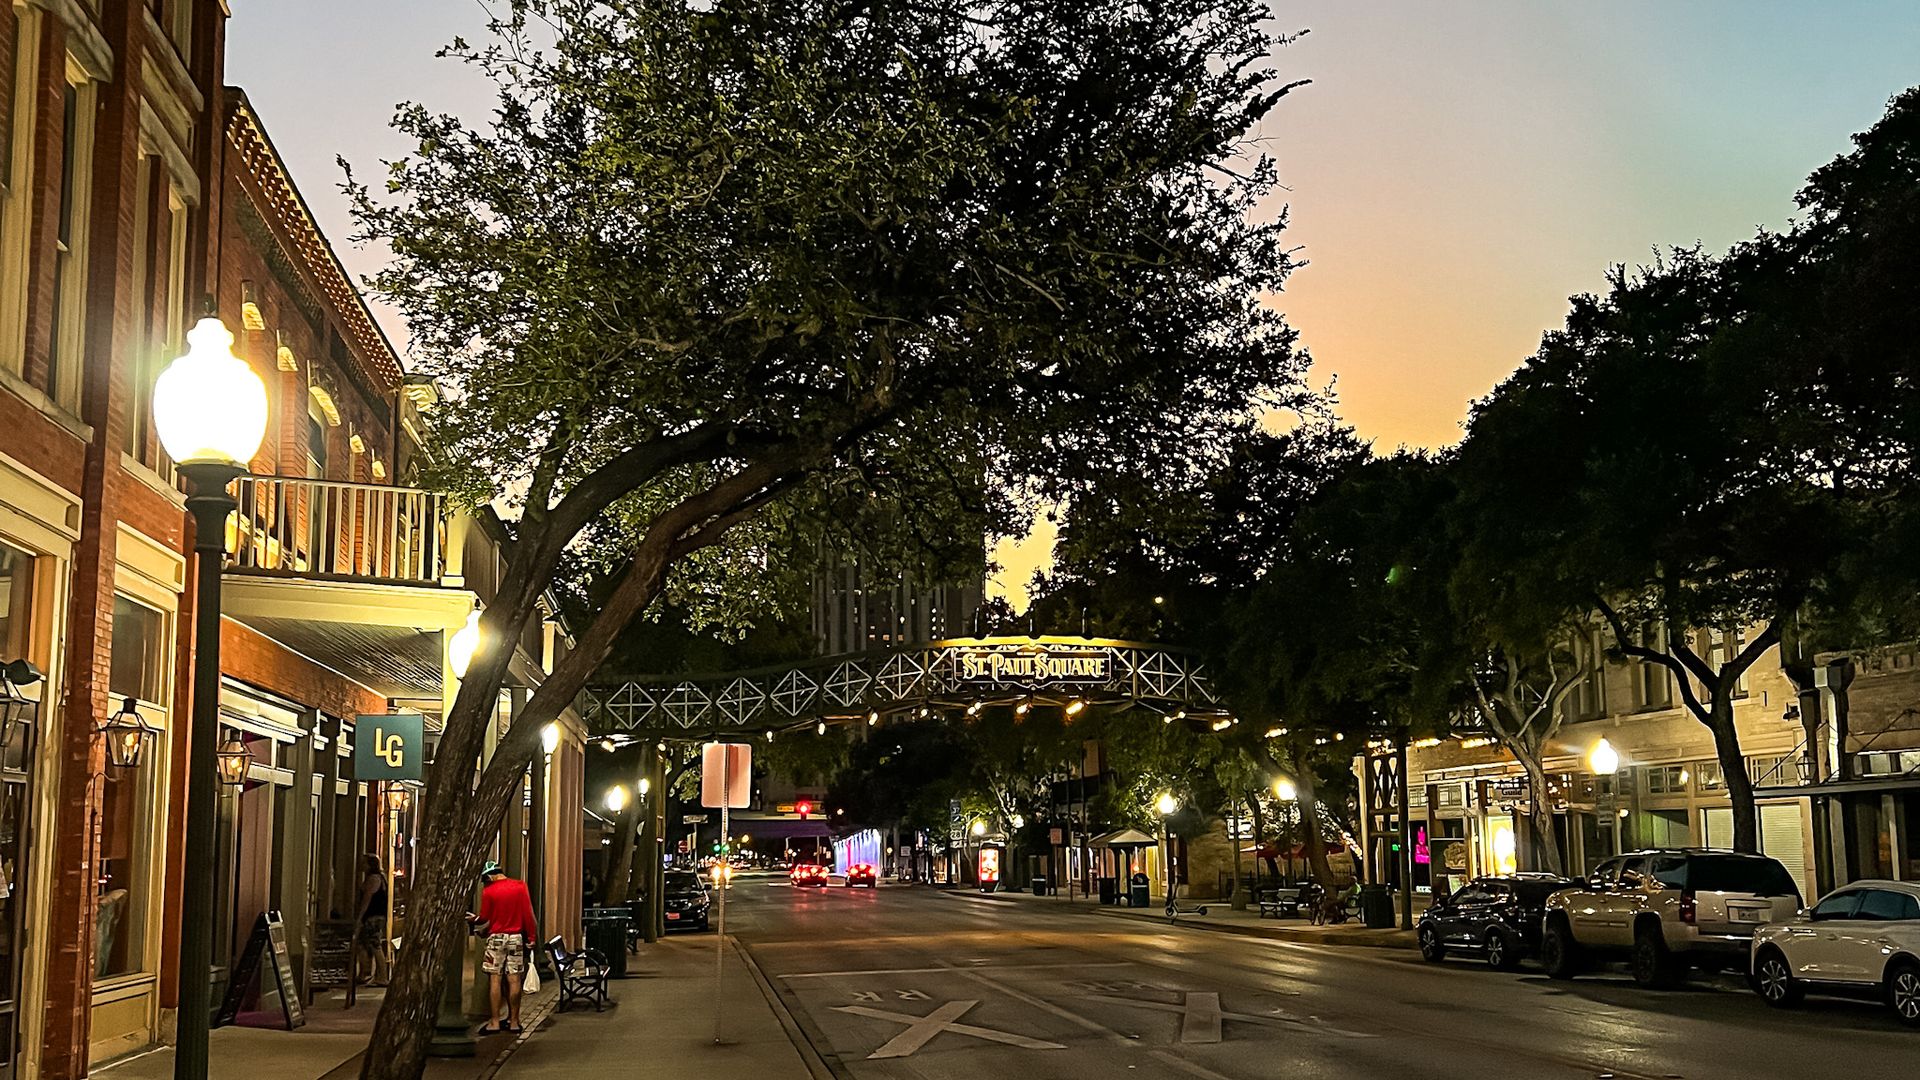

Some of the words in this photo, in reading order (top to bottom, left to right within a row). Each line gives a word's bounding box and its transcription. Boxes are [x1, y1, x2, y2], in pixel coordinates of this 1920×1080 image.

[987, 652, 1035, 682] PAUL
[1034, 652, 1105, 680] SQUARE
[375, 727, 404, 767] LG
